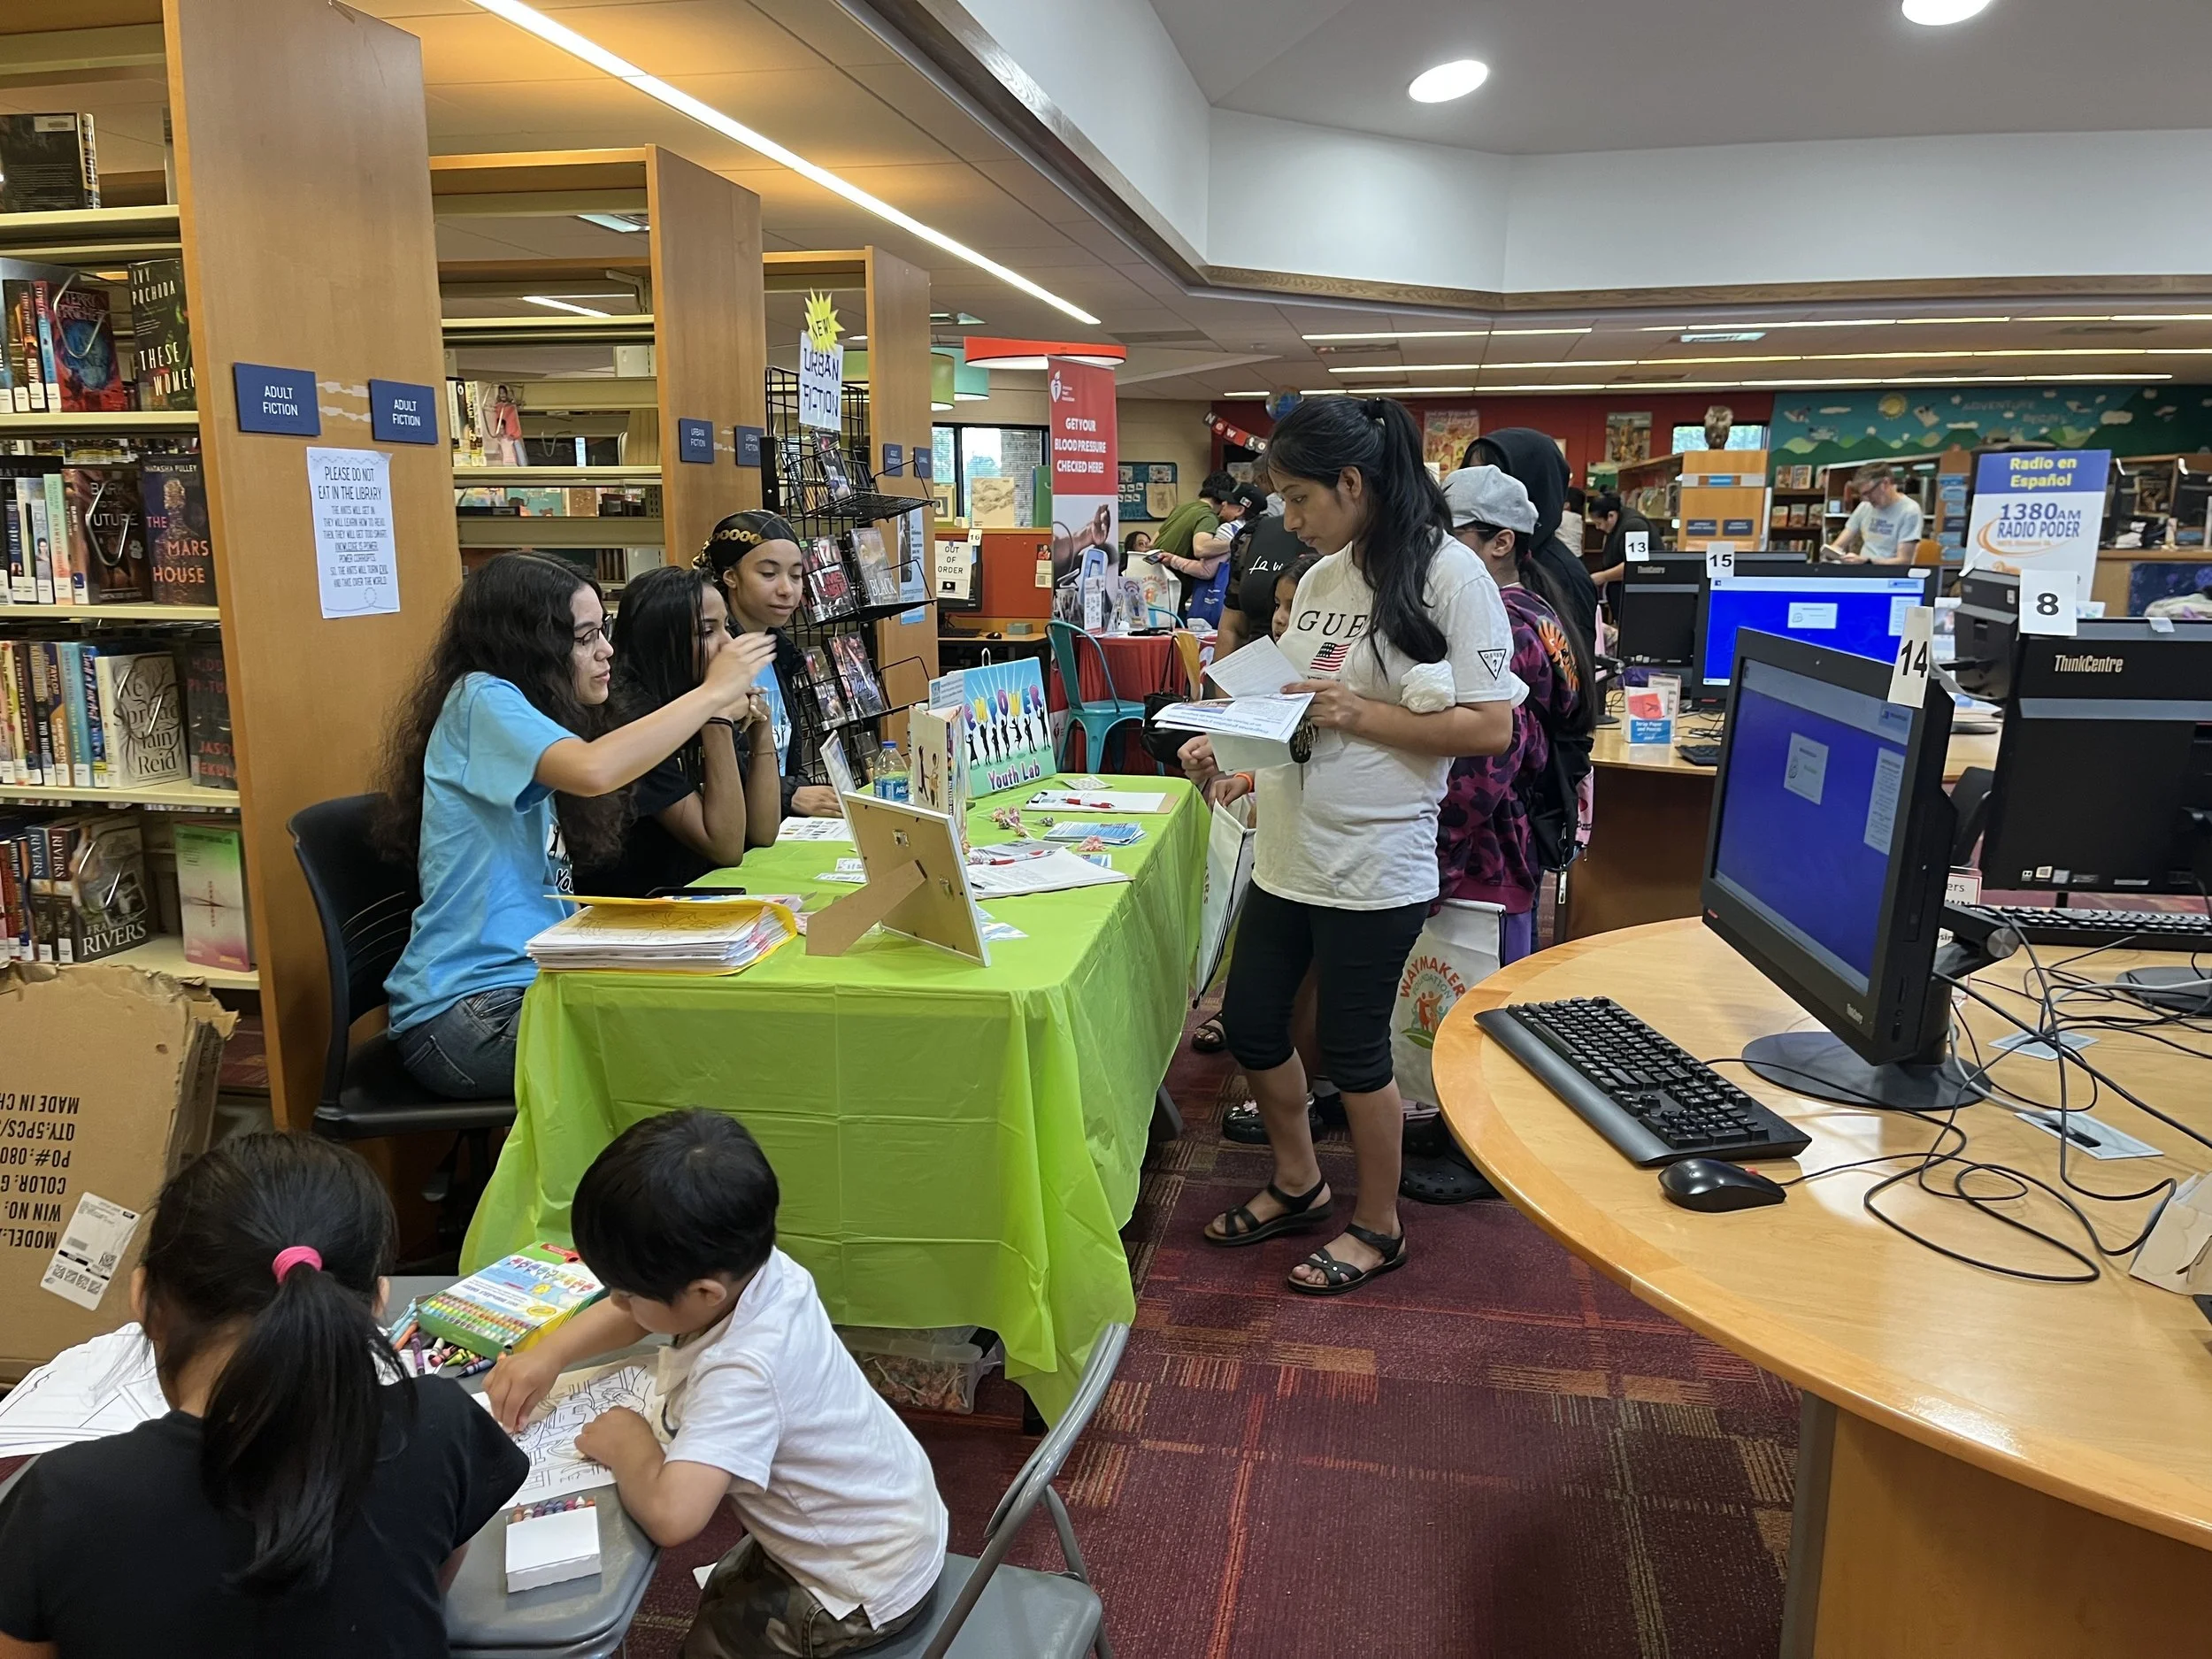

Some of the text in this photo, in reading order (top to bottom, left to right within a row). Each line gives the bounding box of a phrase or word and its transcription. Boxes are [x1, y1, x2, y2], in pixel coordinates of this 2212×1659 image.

[134, 268, 150, 285] IVY
[133, 280, 176, 304] POCHODA
[811, 318, 832, 341] NEW!
[140, 342, 180, 371] THESE
[804, 348, 839, 381] URBAN
[154, 367, 196, 396] WOMEN
[265, 386, 293, 399] ADULT
[803, 384, 838, 417] FICTION
[263, 402, 298, 416] FICTION
[394, 400, 417, 411] ADULT
[393, 414, 421, 426] FICTION
[1065, 418, 1096, 432] GET YOUR
[691, 438, 706, 447] FICTION
[1055, 438, 1106, 454] BLOOD PRESSURE
[1056, 459, 1087, 473] CHECKED
[2010, 457, 2077, 470] Radio en
[325, 466, 374, 482] PLEASE DO NOT
[2010, 473, 2071, 489] Español
[319, 486, 382, 501] EAT IN THE LIBRARY
[87, 513, 139, 526] UTURE
[147, 517, 167, 528] THE
[1997, 520, 2080, 538] RADIO PODER
[167, 541, 209, 557] MARS
[1628, 542, 1647, 553] 13
[1248, 556, 1269, 574] La
[1709, 554, 1732, 567] 15
[153, 567, 205, 584] HOUSE
[870, 578, 897, 596] BLACK
[2036, 592, 2059, 616] 8
[1901, 640, 1928, 678] 14
[2055, 655, 2124, 672] ThinkCentre
[50, 664, 59, 695] TAYLOR
[964, 685, 1042, 731] EMPOWER
[39, 722, 48, 735] TWO
[139, 750, 176, 774] Reid
[988, 759, 1041, 790] Youth Lab
[30, 833, 42, 876] RIVERS
[51, 835, 65, 879] RIVERS
[83, 920, 147, 956] RIVERS
[1401, 956, 1466, 1002] WAYMAKER
[19, 1094, 35, 1113] IN
[39, 1095, 80, 1115] MADE
[0, 1118, 75, 1141] QTY:5PCS/
[14, 1175, 66, 1195] COLOR:
[4, 1201, 29, 1220] NO:
[32, 1202, 61, 1223] WIN
[0, 1228, 57, 1249] MODEL:
